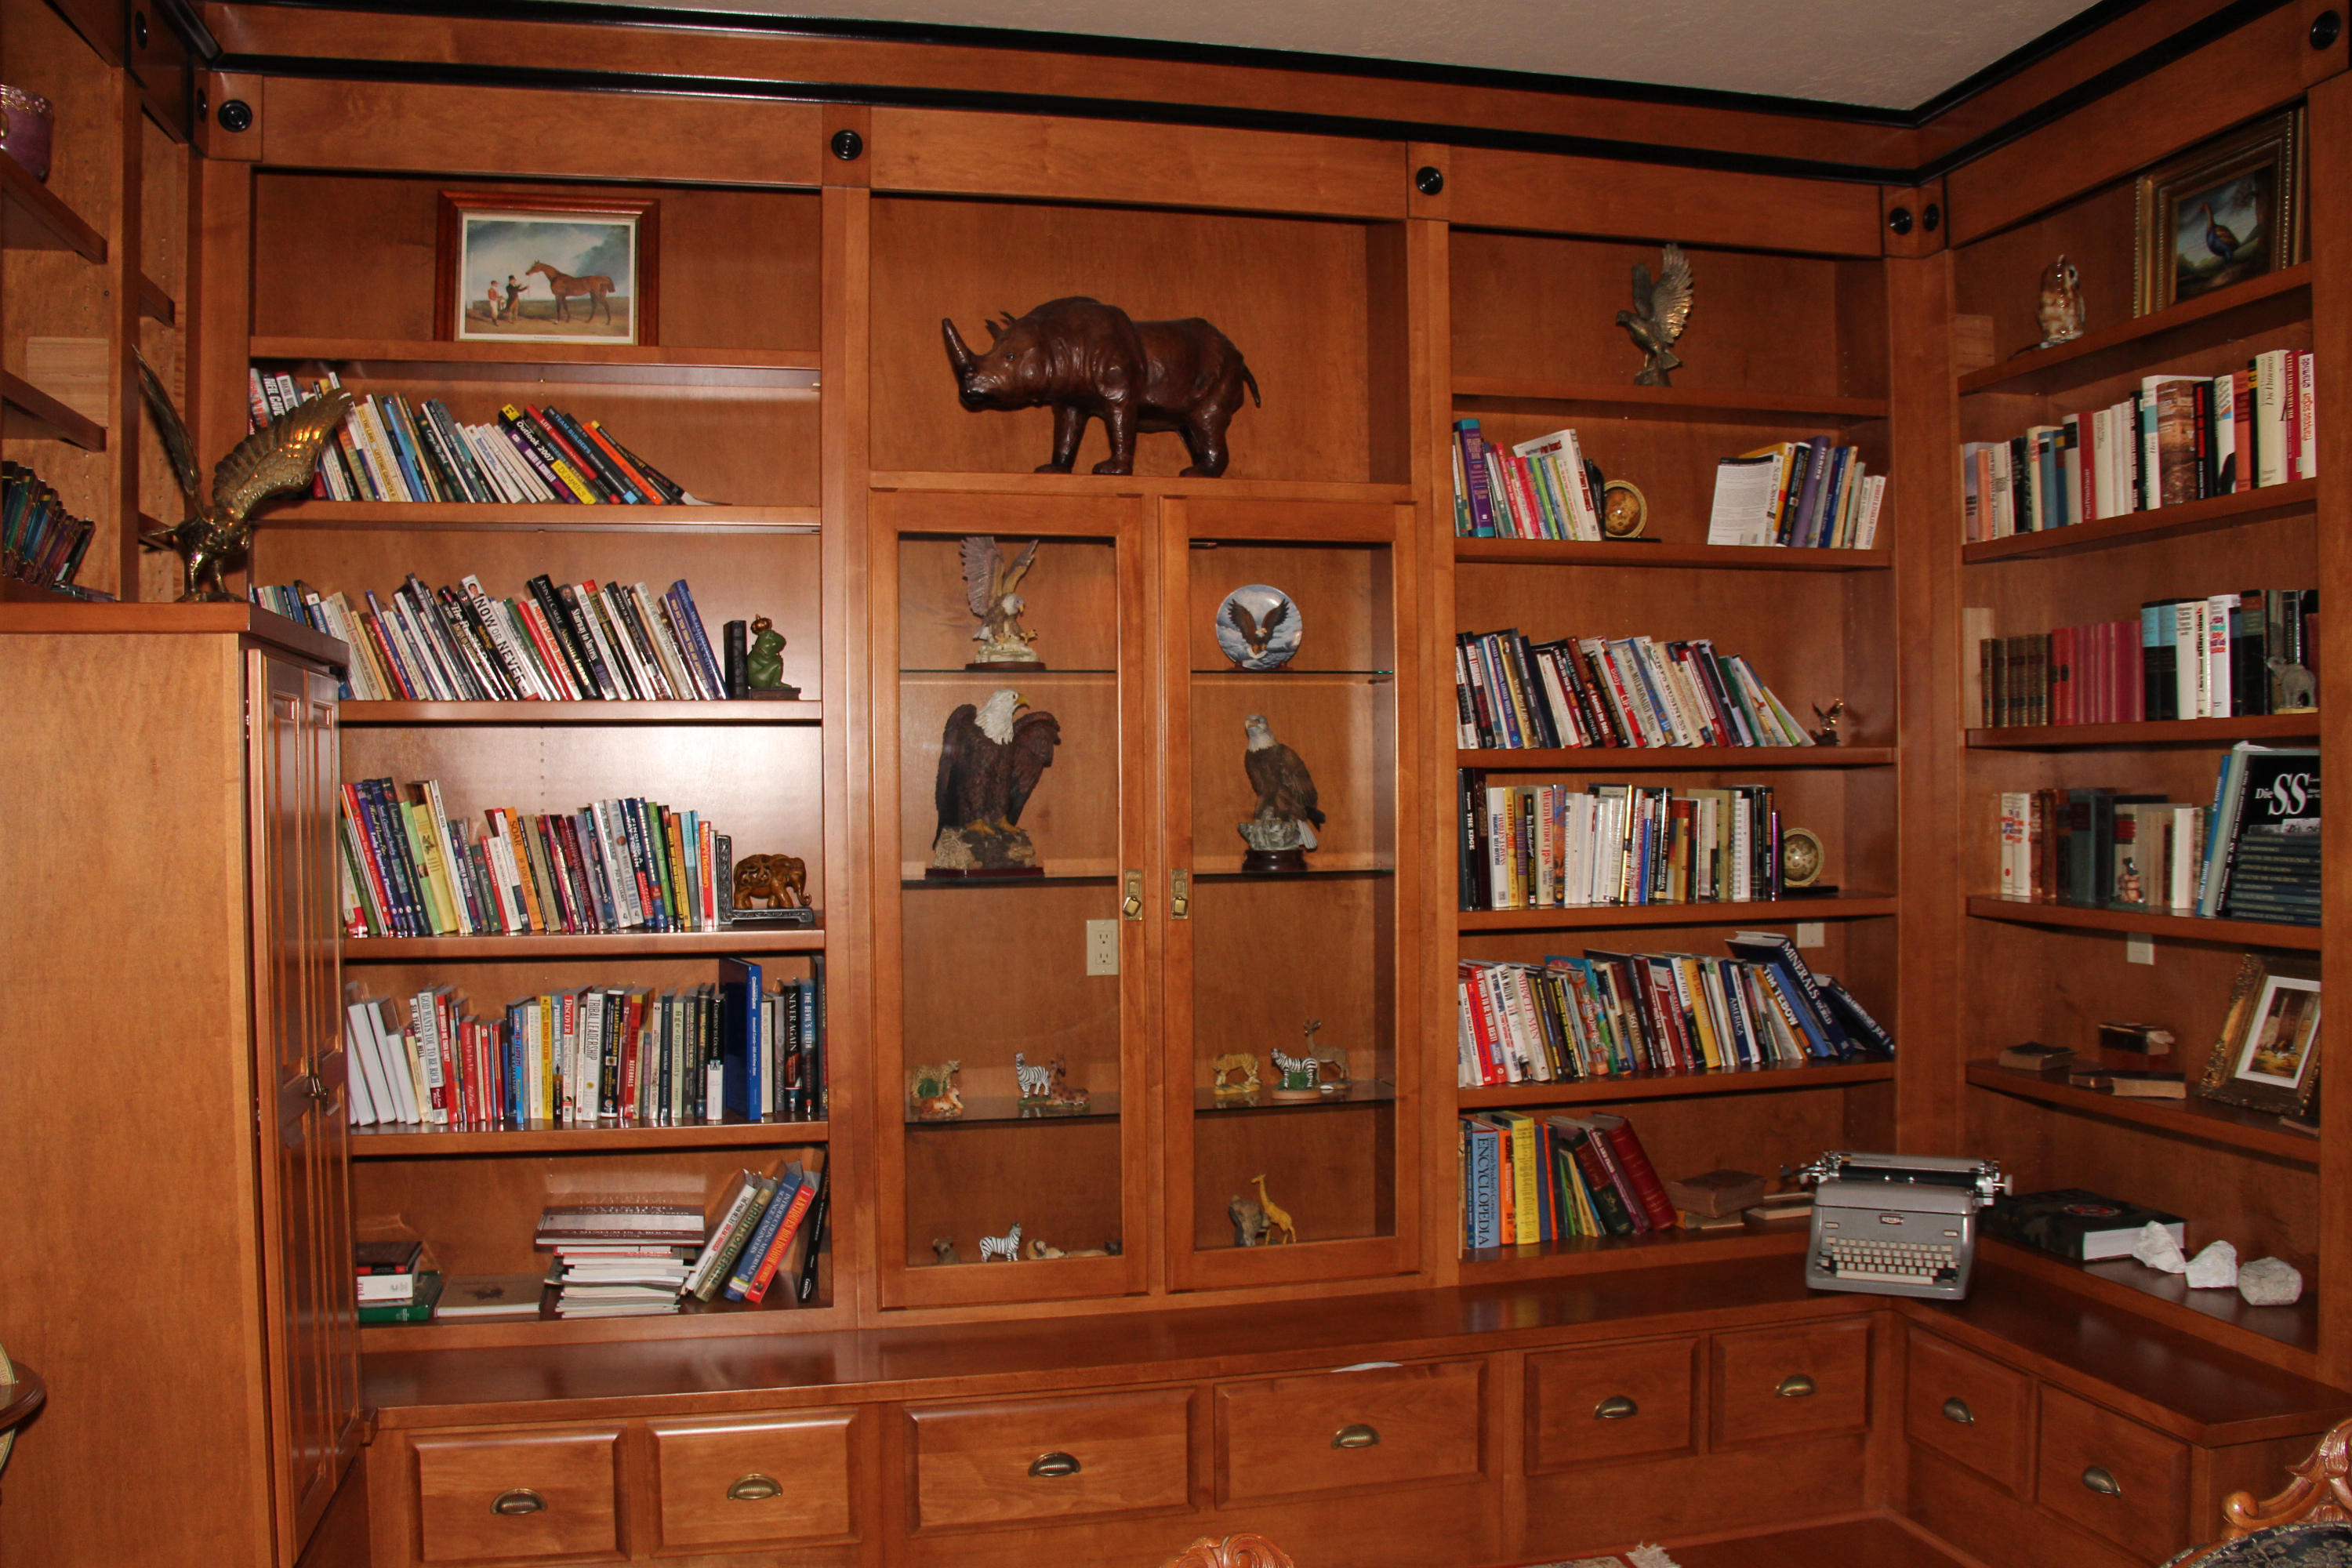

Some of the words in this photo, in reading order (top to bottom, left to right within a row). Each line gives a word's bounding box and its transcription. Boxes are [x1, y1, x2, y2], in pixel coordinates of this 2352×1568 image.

[515, 418, 541, 448] Outlook
[536, 444, 555, 463] 2007
[474, 597, 498, 630] NOW
[590, 593, 608, 622] TRUMP
[490, 626, 503, 641] OR
[549, 637, 560, 652] AND
[568, 606, 589, 634] Stairway
[583, 638, 600, 661] Success
[495, 639, 527, 684] NEVER
[1590, 693, 1603, 713] Against
[1619, 694, 1632, 713] LIFE
[1663, 684, 1687, 731] BUSINESS
[2255, 787, 2274, 800] Die
[2270, 771, 2310, 815] SS
[507, 819, 524, 848] SOAR
[630, 817, 642, 855] FINDING
[1779, 940, 1821, 1000] MINERALS
[420, 994, 431, 1010] GOD
[1477, 978, 1488, 998] POWER
[1761, 965, 1778, 989] TIM
[1773, 988, 1798, 1027] TEBOW
[423, 1010, 434, 1033] WANTS
[588, 999, 599, 1019] TRIBAL
[587, 1021, 600, 1060] LEADERSHIP
[1526, 1016, 1540, 1040] MAN
[767, 1189, 785, 1217] SCIENCE
[1476, 1137, 1490, 1246] ENCYCLOPEDIA
[735, 1200, 764, 1238] HABITS
[764, 1192, 791, 1239] INTRODUCTION
[782, 1194, 807, 1229] ANTIQUES
[730, 1234, 743, 1248] OF
[748, 1218, 771, 1254] ENGINEERS
[765, 1226, 791, 1265] ROADSHOW
[706, 1244, 738, 1286] WEALTH
[746, 1241, 768, 1276] MATERIALS
